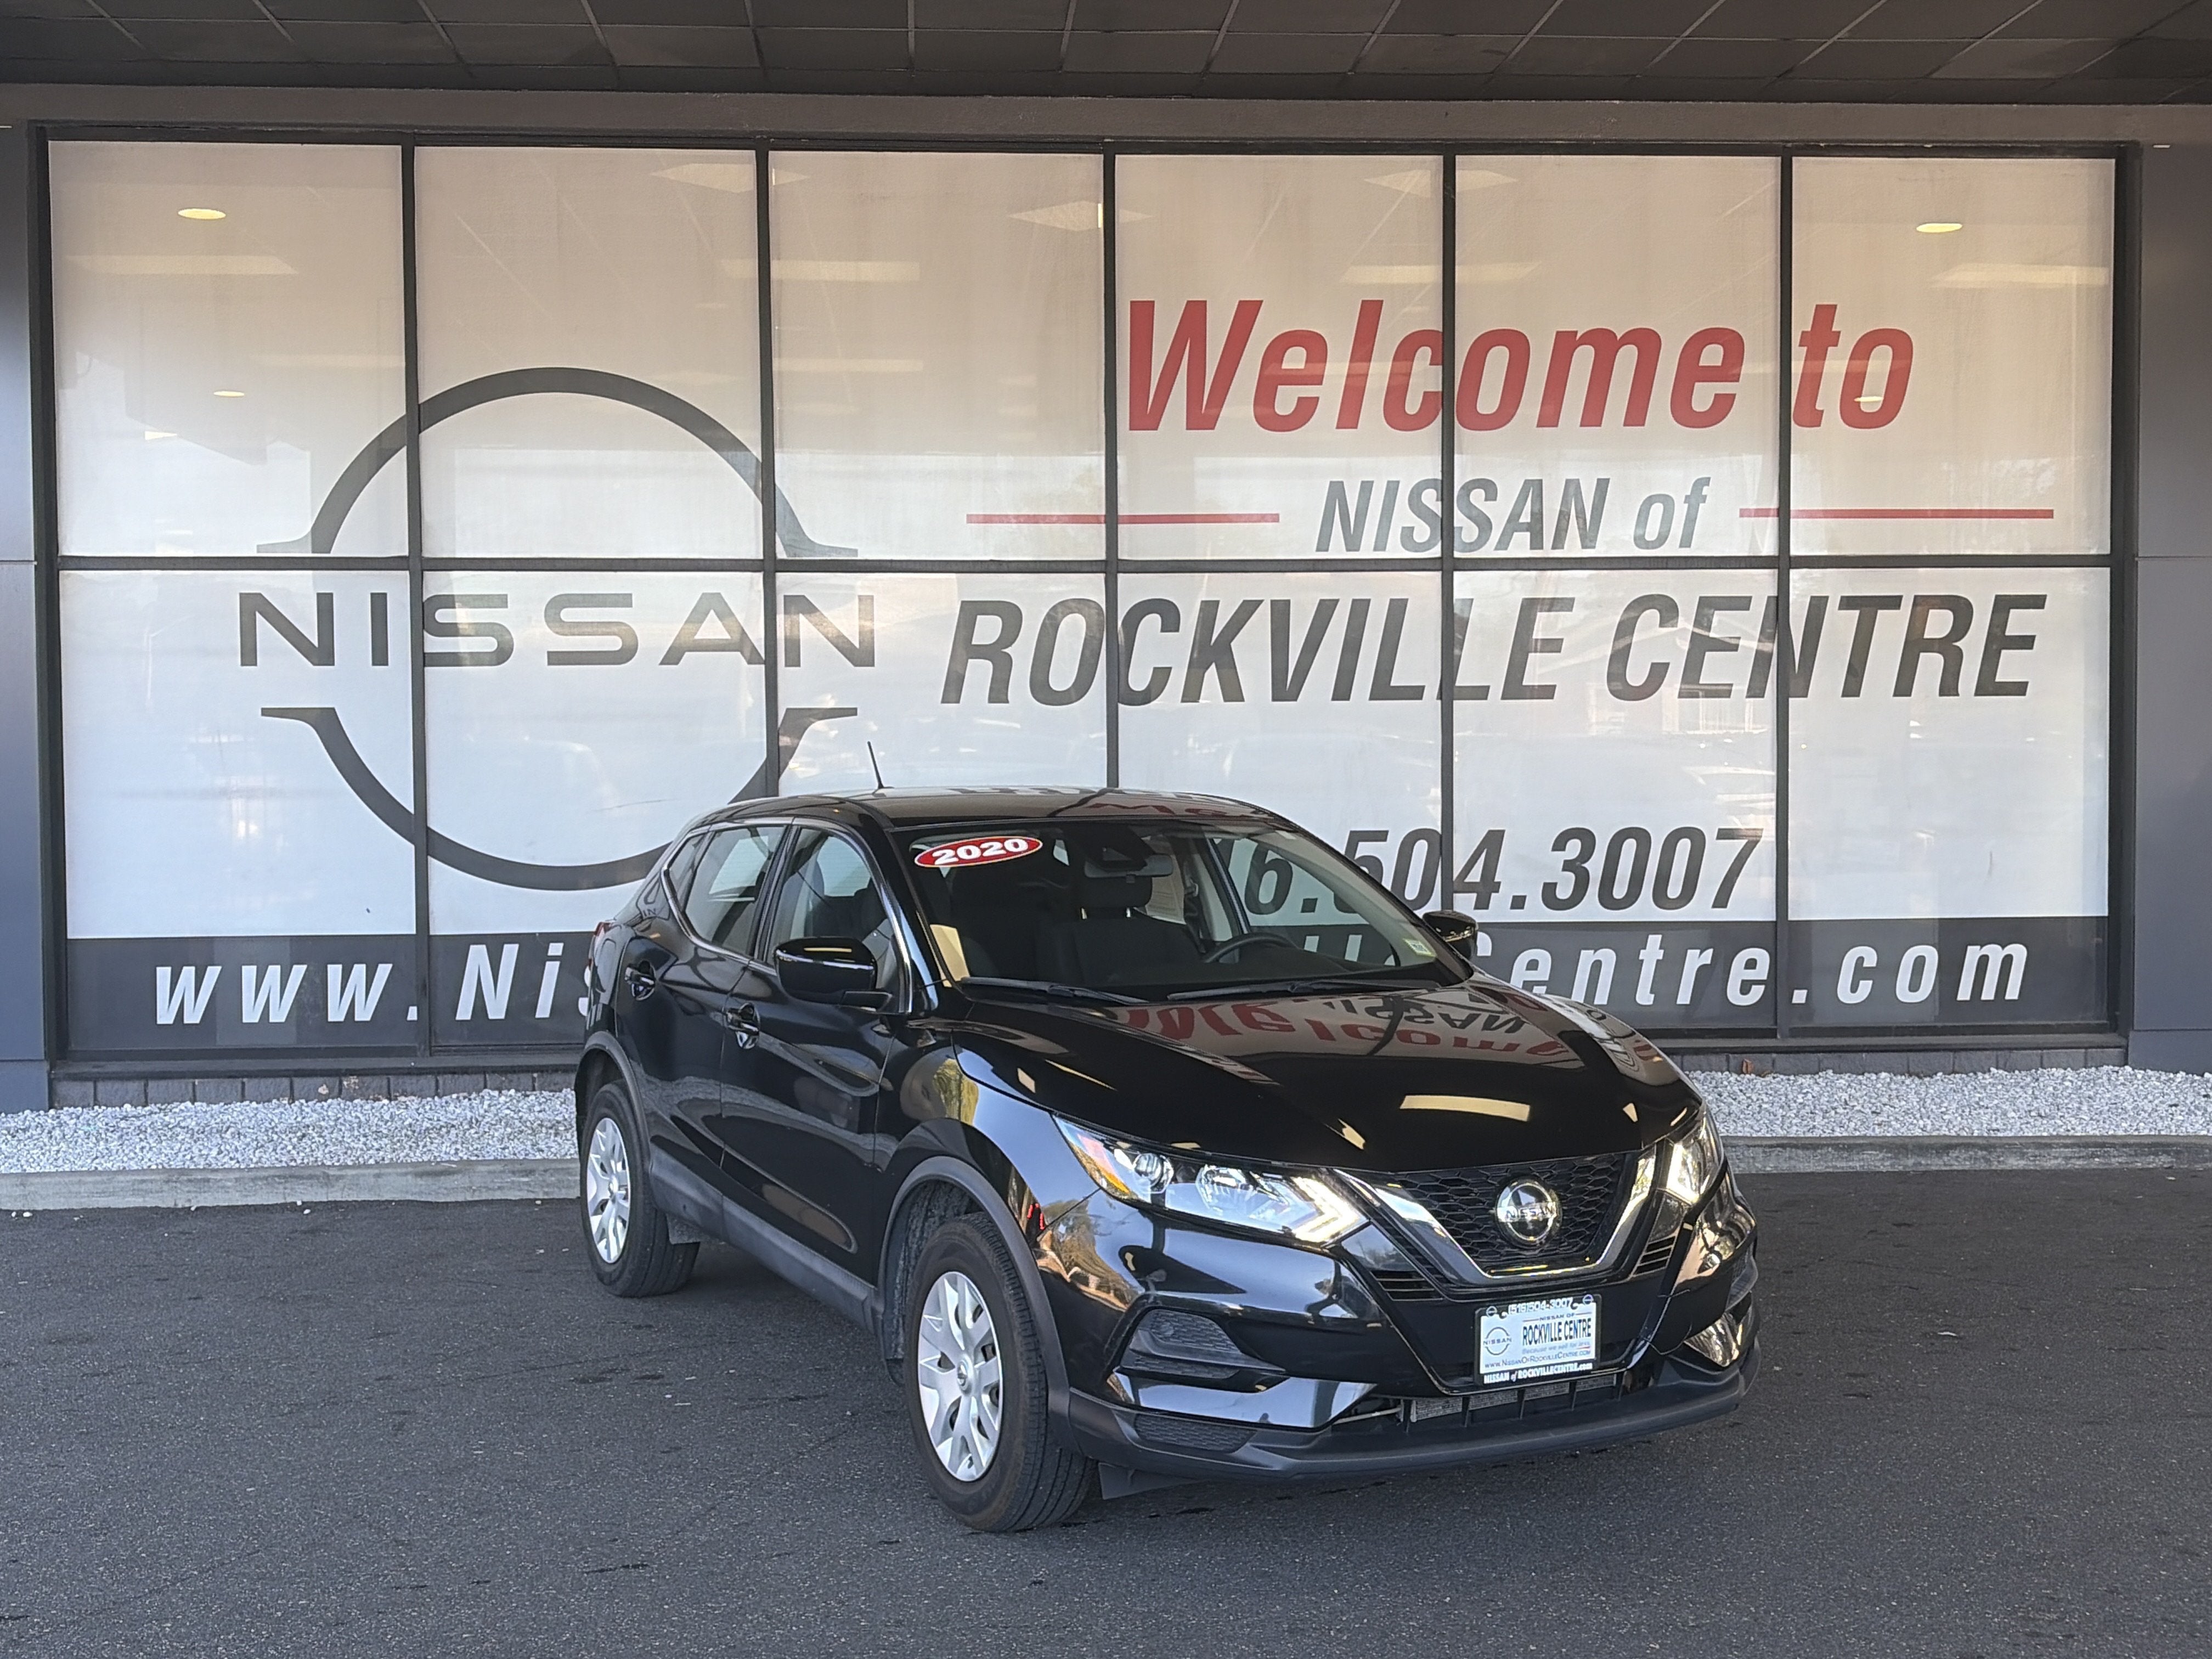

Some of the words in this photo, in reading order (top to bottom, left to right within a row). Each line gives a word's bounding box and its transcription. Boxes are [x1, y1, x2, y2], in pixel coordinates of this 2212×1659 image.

[1128, 300, 1745, 432] Welcome
[1793, 303, 1914, 431] to
[1317, 477, 1609, 553] NISSAN
[1633, 476, 1710, 549] of
[239, 591, 876, 668] NISSAN
[941, 595, 1577, 708] ROCKVILLE
[1607, 594, 2047, 702] CENTRE
[932, 838, 1029, 865] 2020
[1522, 1322, 1562, 1346] ROCKVILLE
[1564, 1318, 1591, 1340] CENTRE
[1484, 1372, 1509, 1384] NISSAN
